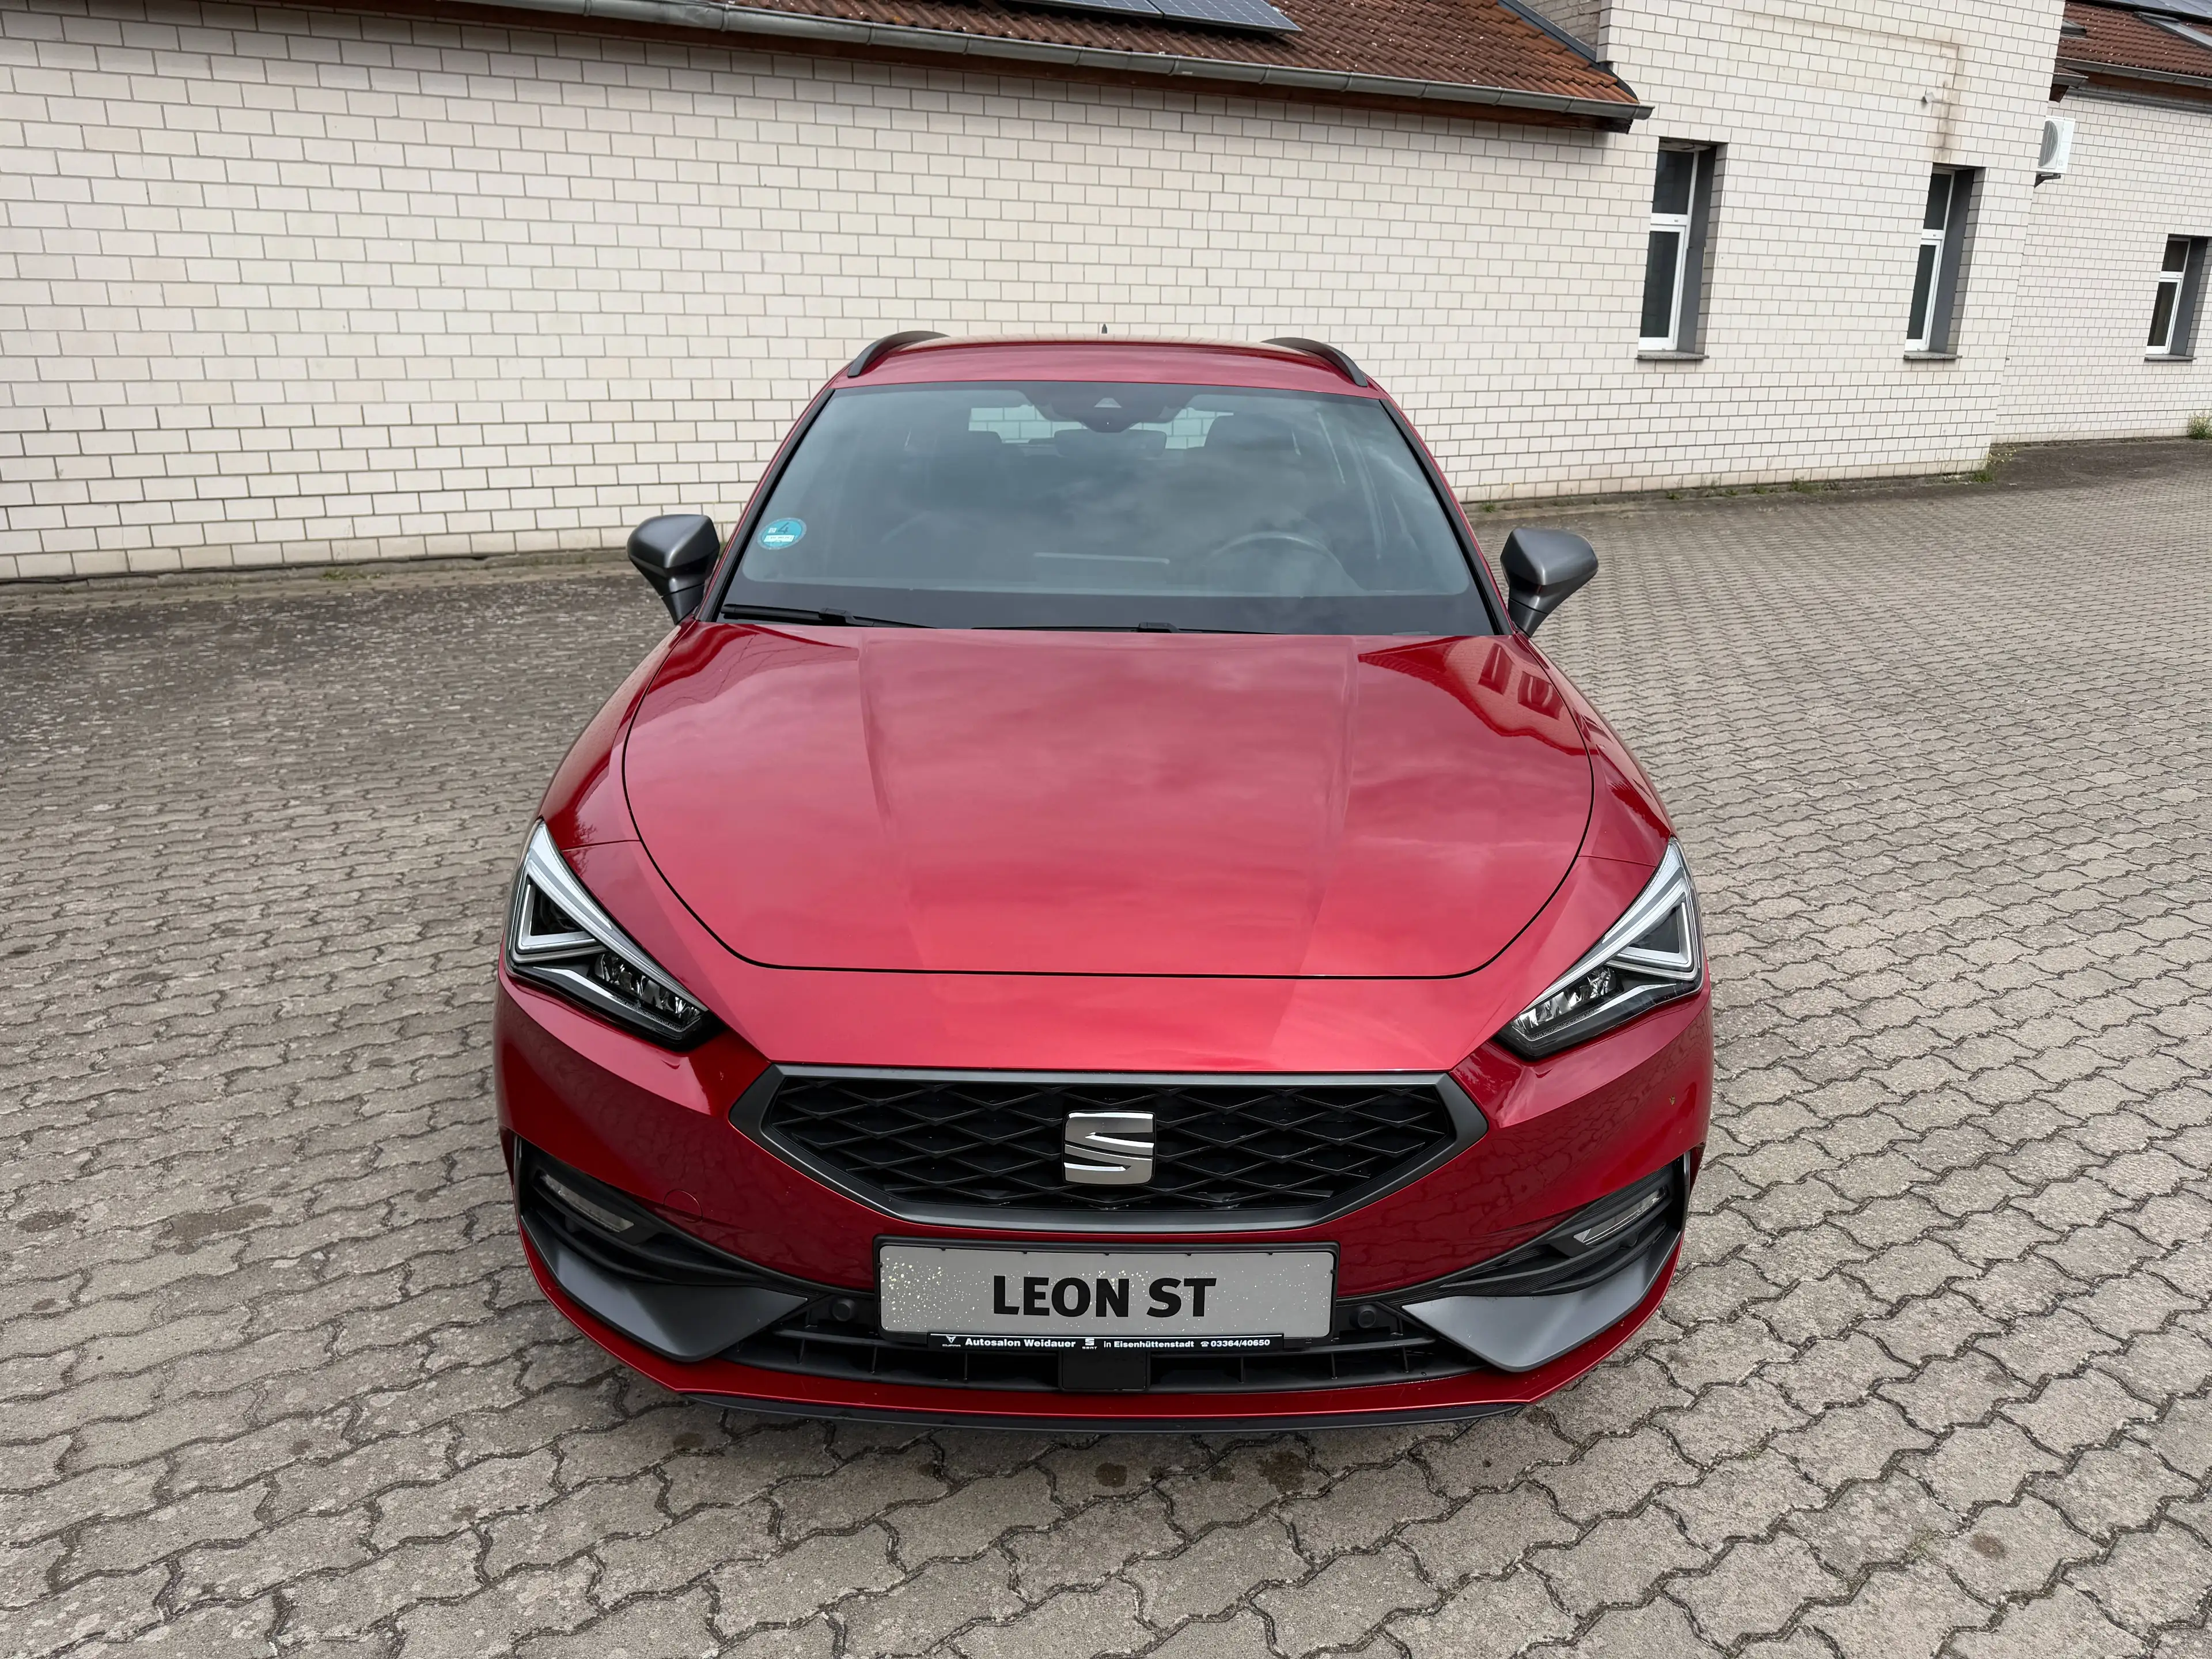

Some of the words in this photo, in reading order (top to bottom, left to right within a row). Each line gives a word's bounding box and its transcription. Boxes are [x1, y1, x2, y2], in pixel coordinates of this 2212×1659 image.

[778, 521, 790, 534] 4
[994, 1275, 1130, 1317] LEON
[1146, 1278, 1217, 1318] ST
[965, 1338, 1021, 1347] Autosalon
[1024, 1339, 1076, 1347] Weidauer
[1210, 1339, 1271, 1347] 03364/40650
